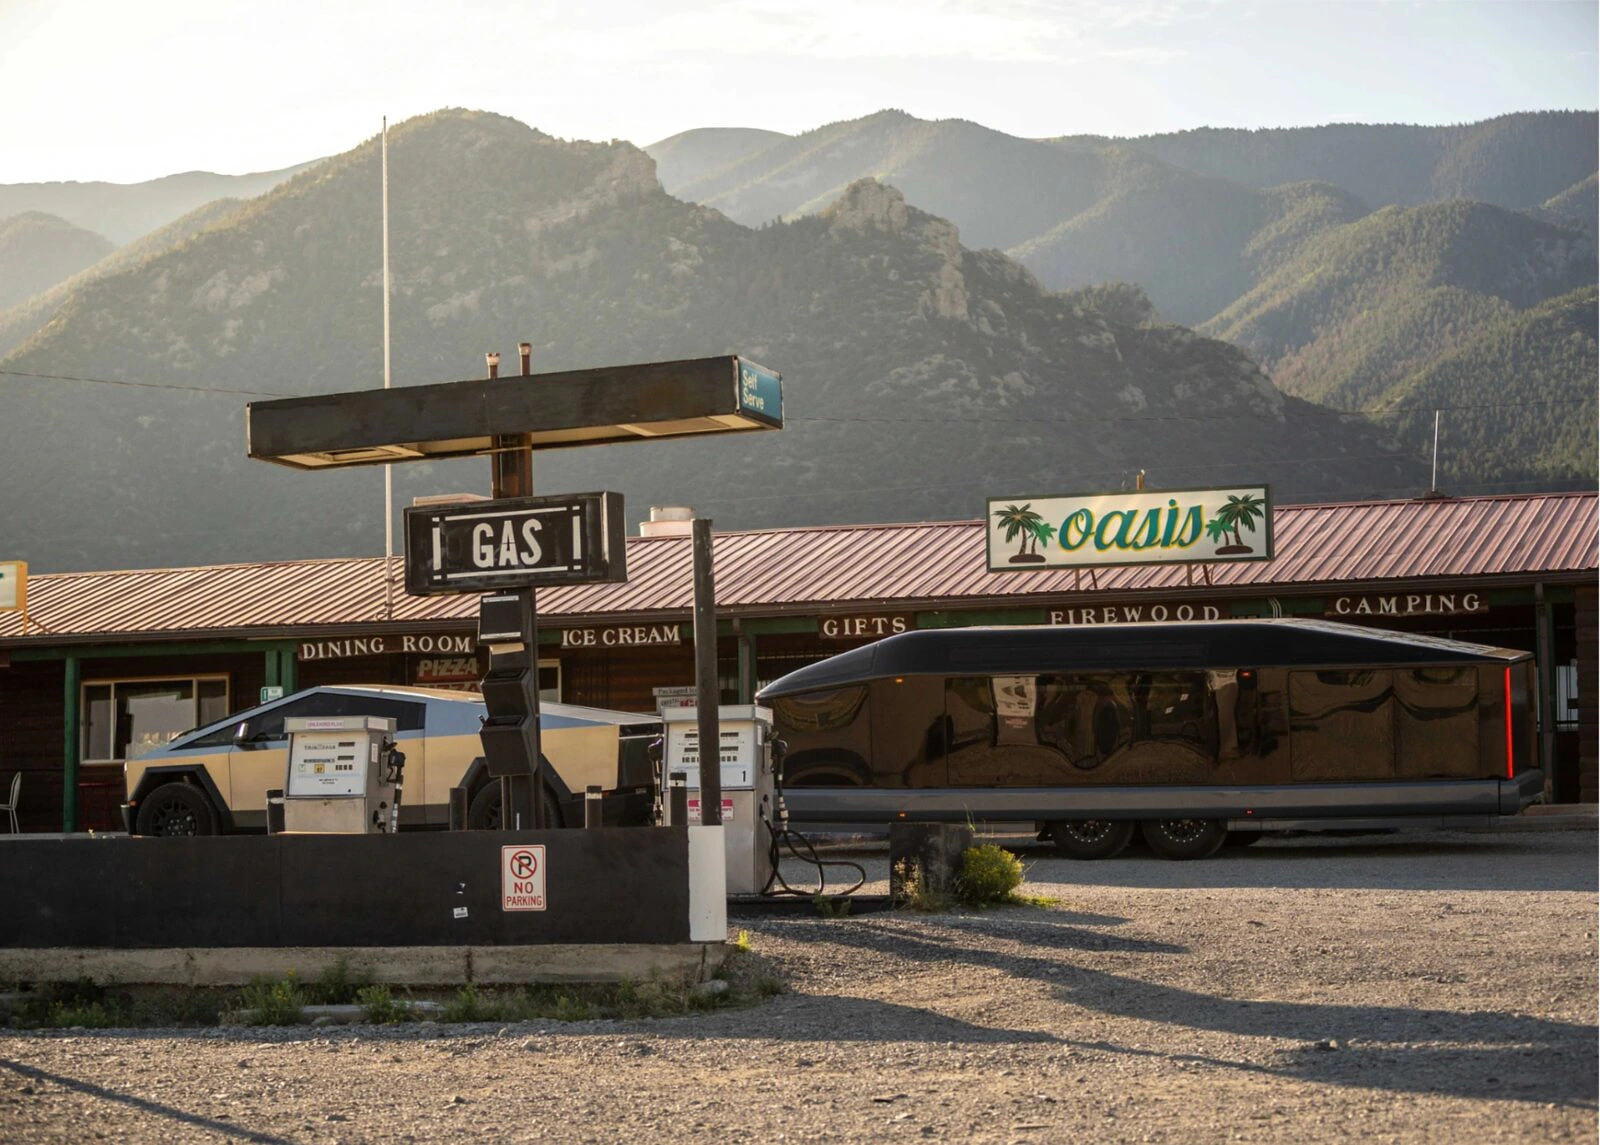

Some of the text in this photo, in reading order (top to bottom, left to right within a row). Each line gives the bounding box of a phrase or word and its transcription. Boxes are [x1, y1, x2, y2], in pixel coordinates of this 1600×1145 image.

[742, 369, 758, 391] Self
[743, 387, 764, 411] Serve
[1059, 498, 1204, 551] oasis
[472, 518, 542, 568] GAS
[1050, 605, 1220, 625] FIREWOOD
[1335, 593, 1480, 615] CAMPING
[562, 624, 680, 646] ICE CREAM
[823, 617, 906, 637] GIFTS
[302, 635, 471, 660] DINING ROOM
[418, 657, 479, 677] PIZZA
[742, 770, 747, 782] 1
[514, 881, 534, 894] NO
[506, 896, 542, 907] PARKING
